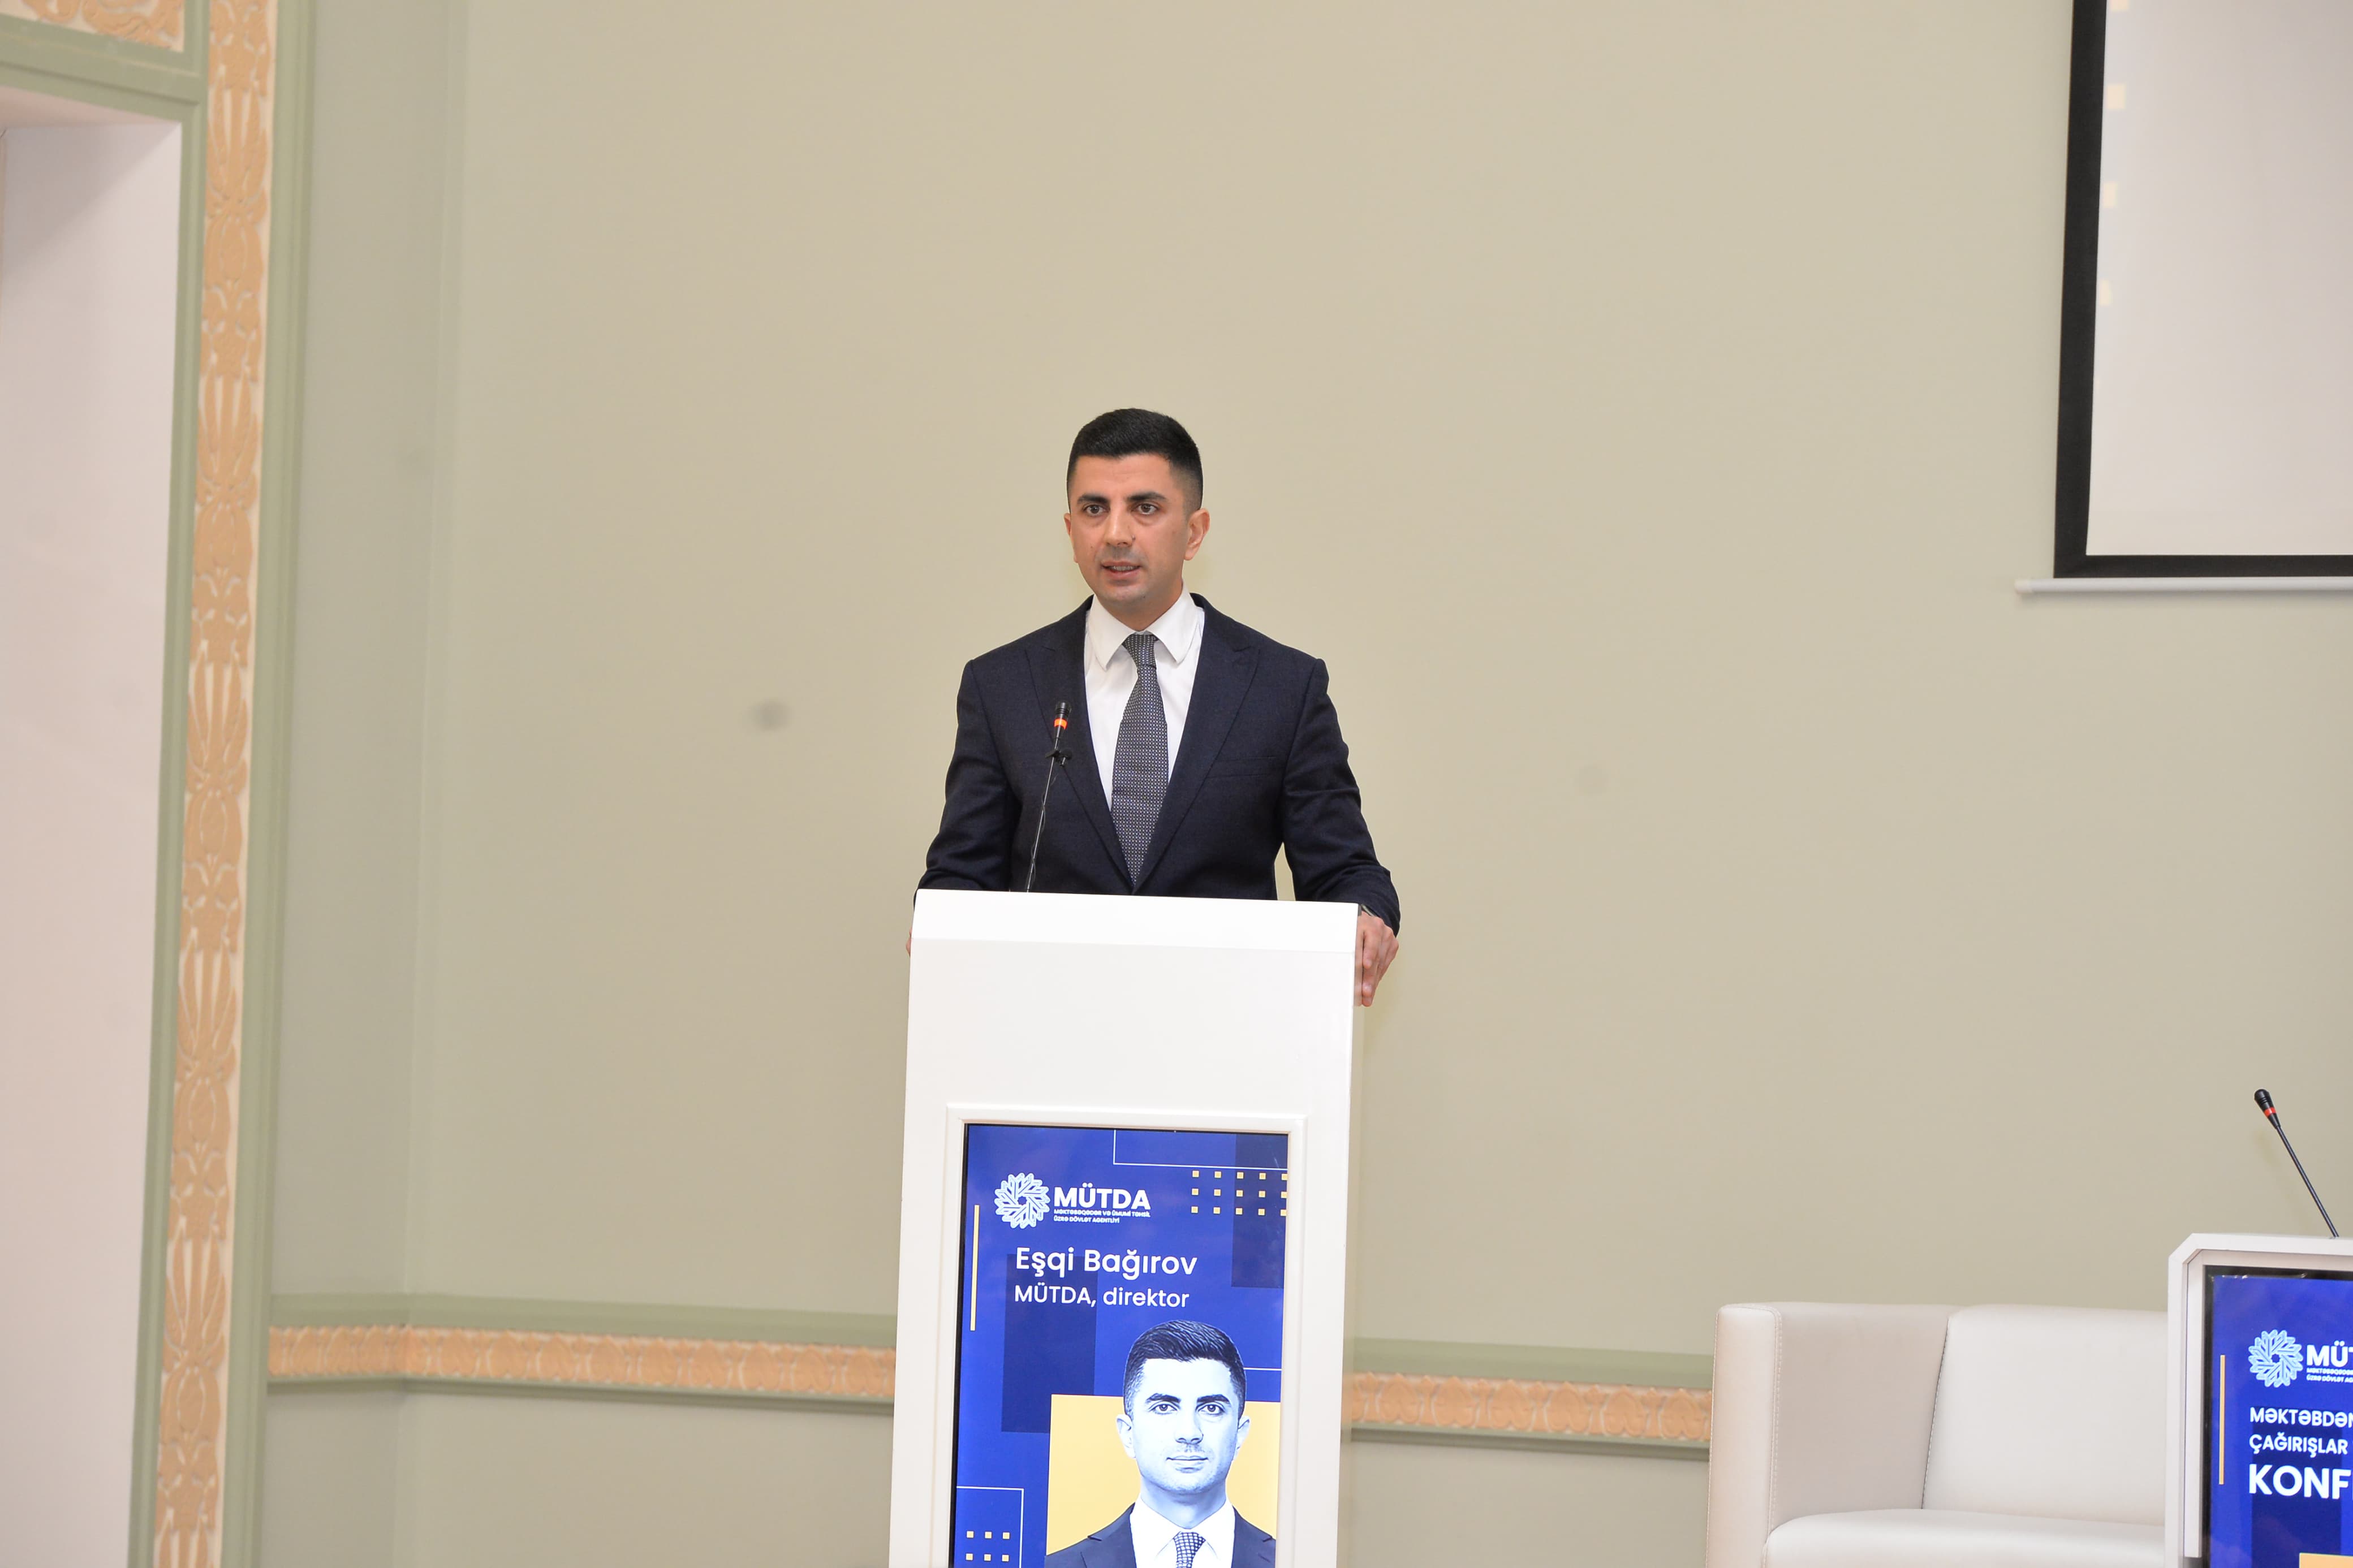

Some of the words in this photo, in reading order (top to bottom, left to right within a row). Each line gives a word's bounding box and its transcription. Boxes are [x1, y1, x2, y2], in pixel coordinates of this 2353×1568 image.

[1054, 1182, 1150, 1210] MÜTDA
[1016, 1246, 1074, 1278] Eşqi
[1084, 1249, 1197, 1280] Bağırov
[1015, 1282, 1096, 1307] MÜTDA,
[1103, 1287, 1190, 1307] direktor
[2249, 1432, 2348, 1458] ÇAĞIRIŞLAR
[2249, 1464, 2353, 1500] KONF
